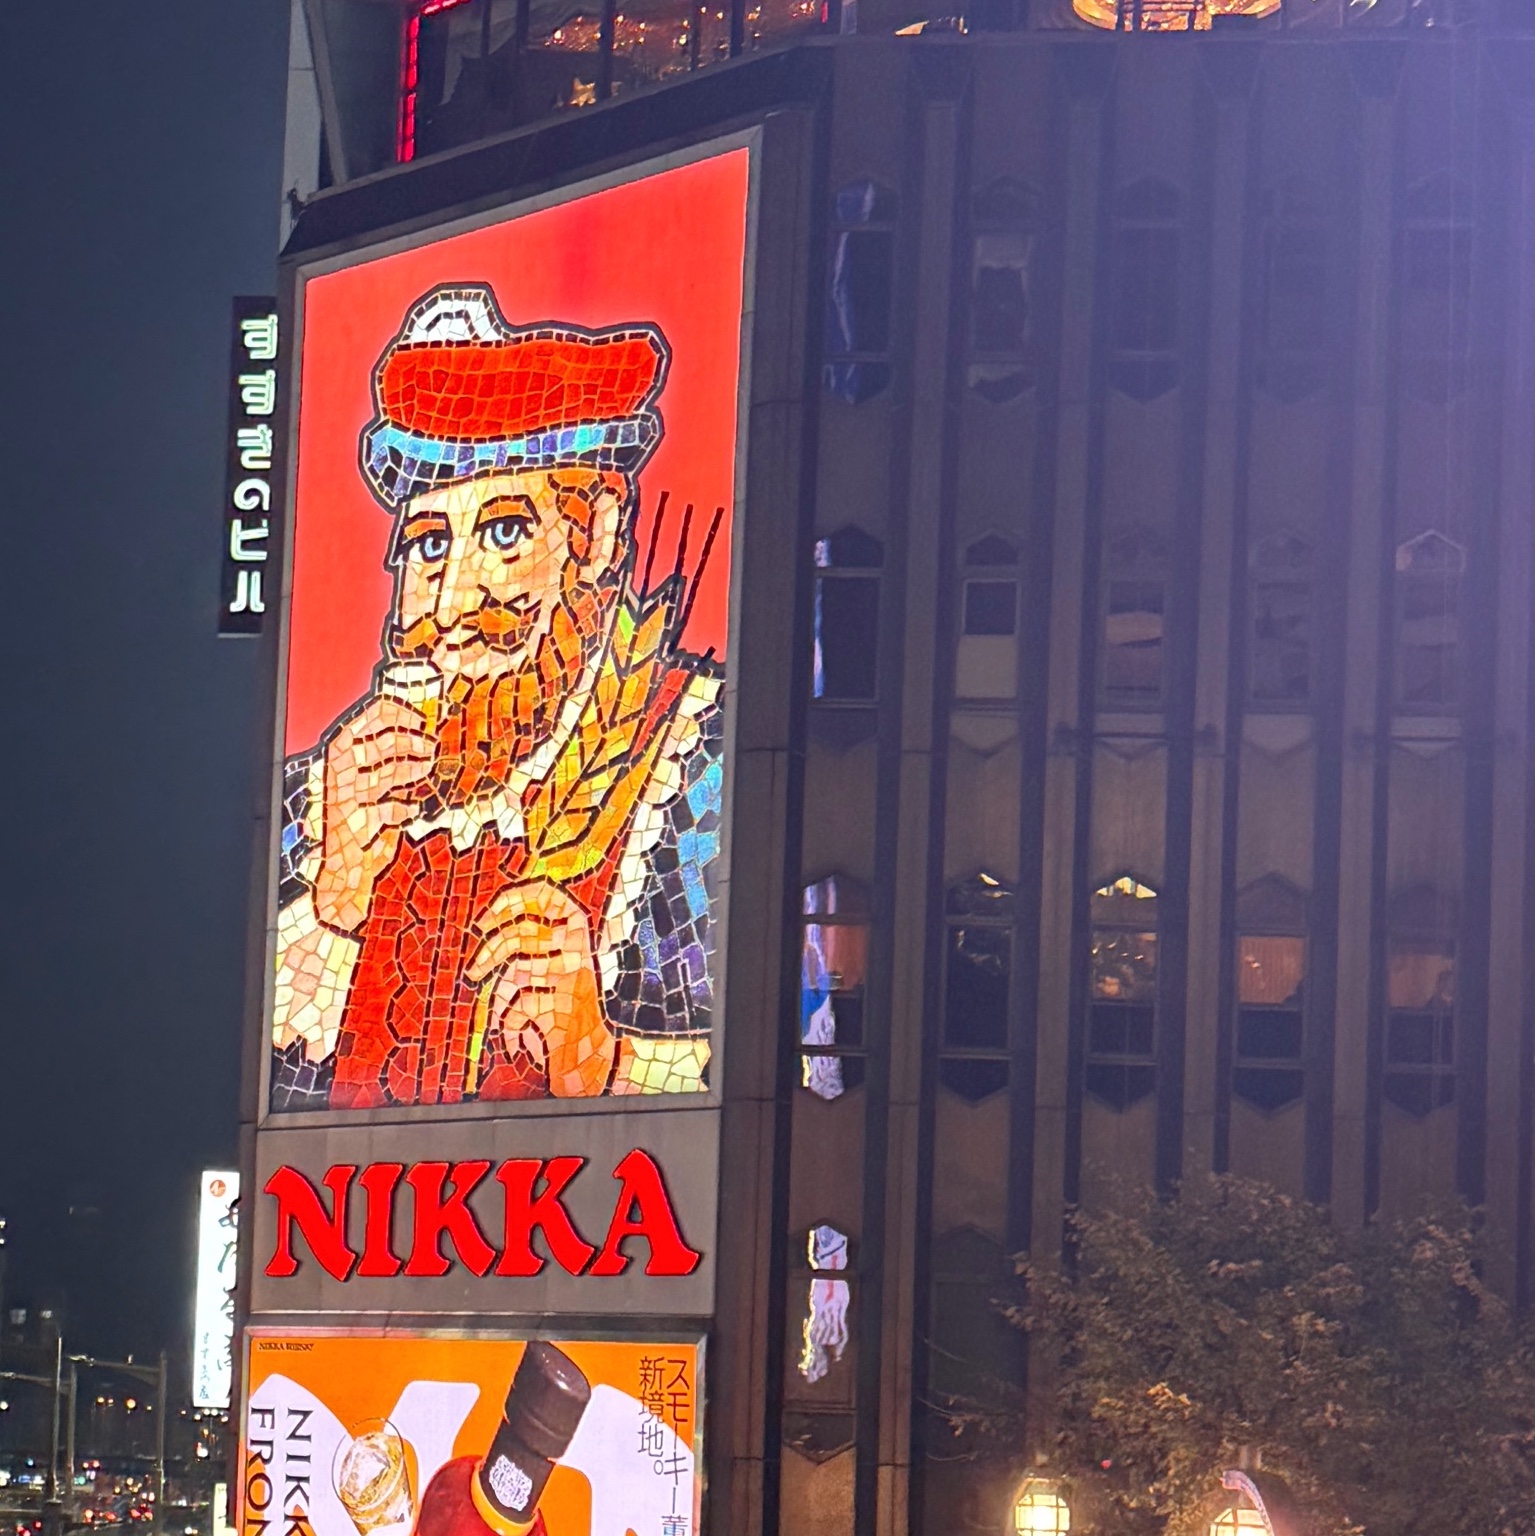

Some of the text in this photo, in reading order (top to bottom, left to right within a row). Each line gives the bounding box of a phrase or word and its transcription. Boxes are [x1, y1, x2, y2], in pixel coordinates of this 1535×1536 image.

[264, 1147, 702, 1282] NIKKA
[637, 1355, 667, 1477] 新境地。
